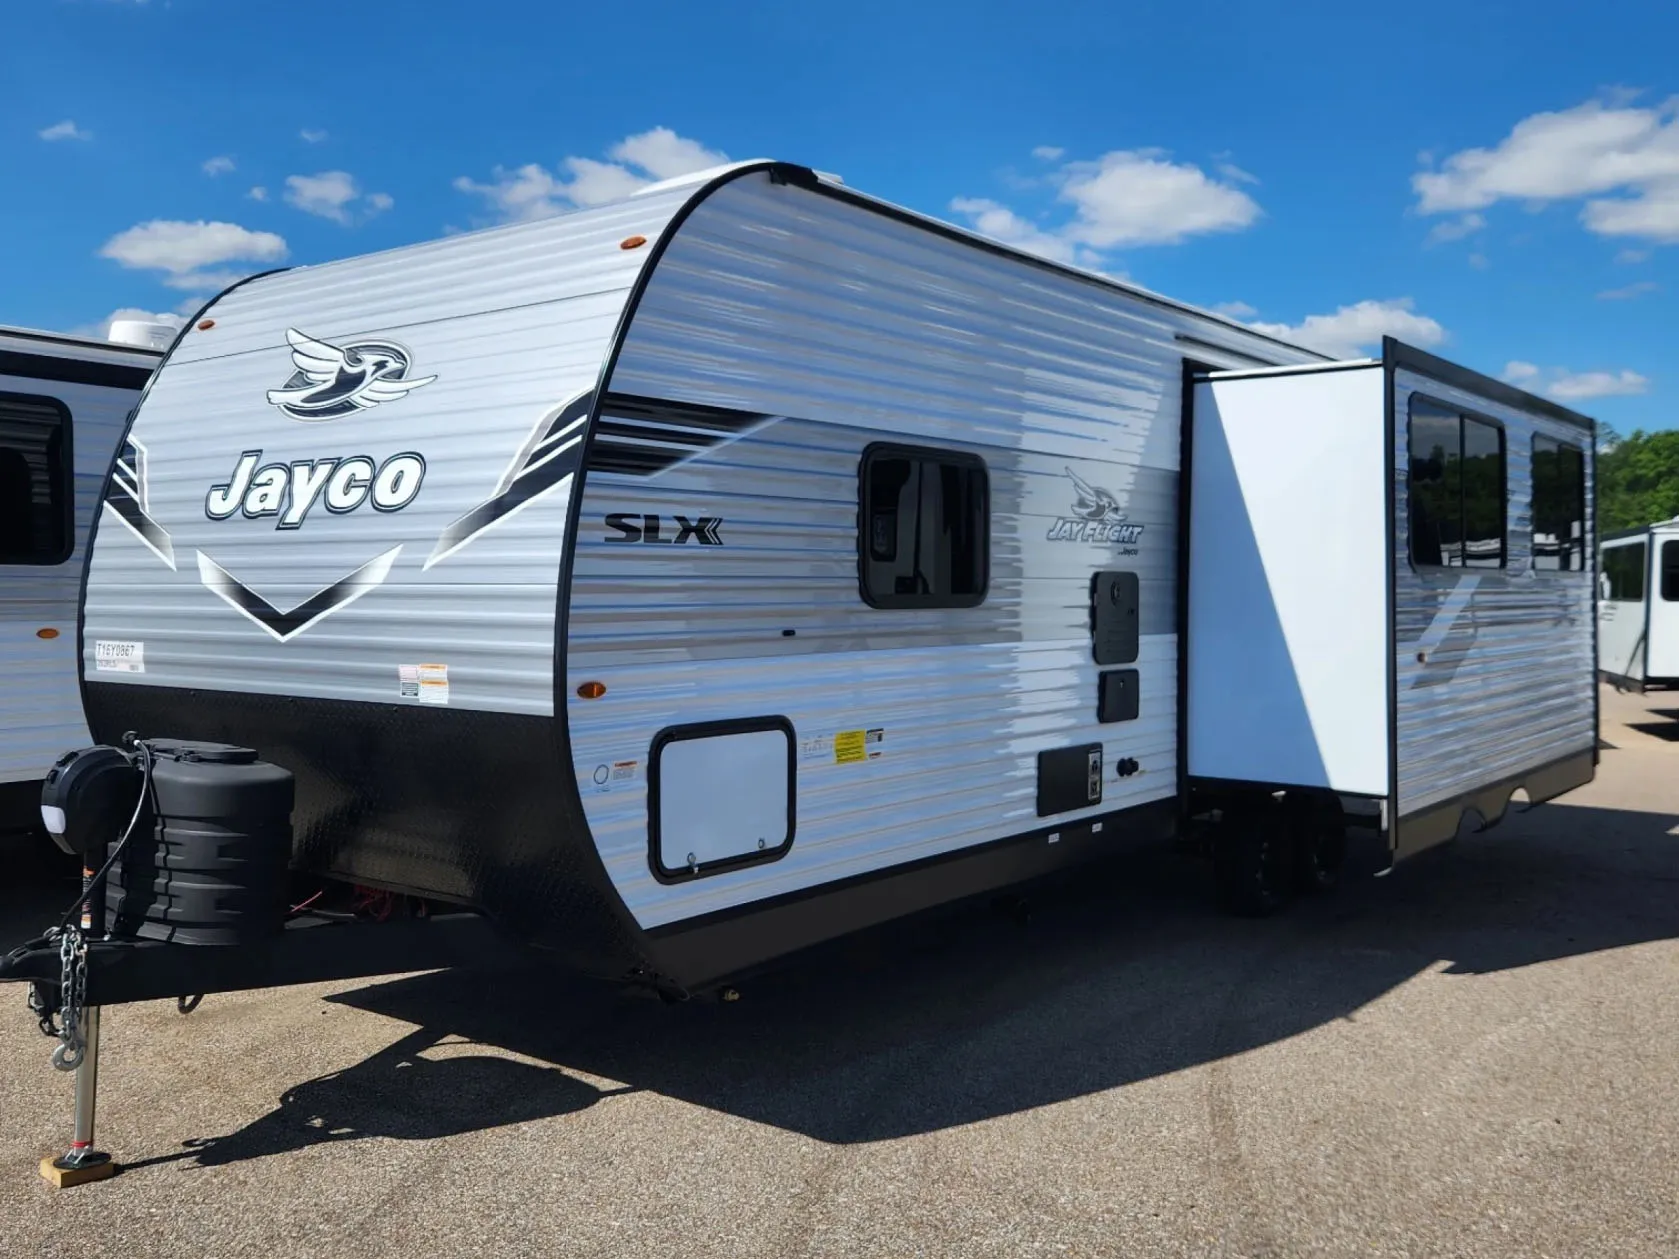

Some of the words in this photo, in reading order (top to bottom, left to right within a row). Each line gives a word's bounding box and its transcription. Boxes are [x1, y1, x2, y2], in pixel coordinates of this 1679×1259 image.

[206, 449, 426, 530] Jayco
[604, 513, 724, 545] SLX
[1047, 517, 1083, 541] JAY
[1081, 520, 1143, 544] FLIGHT
